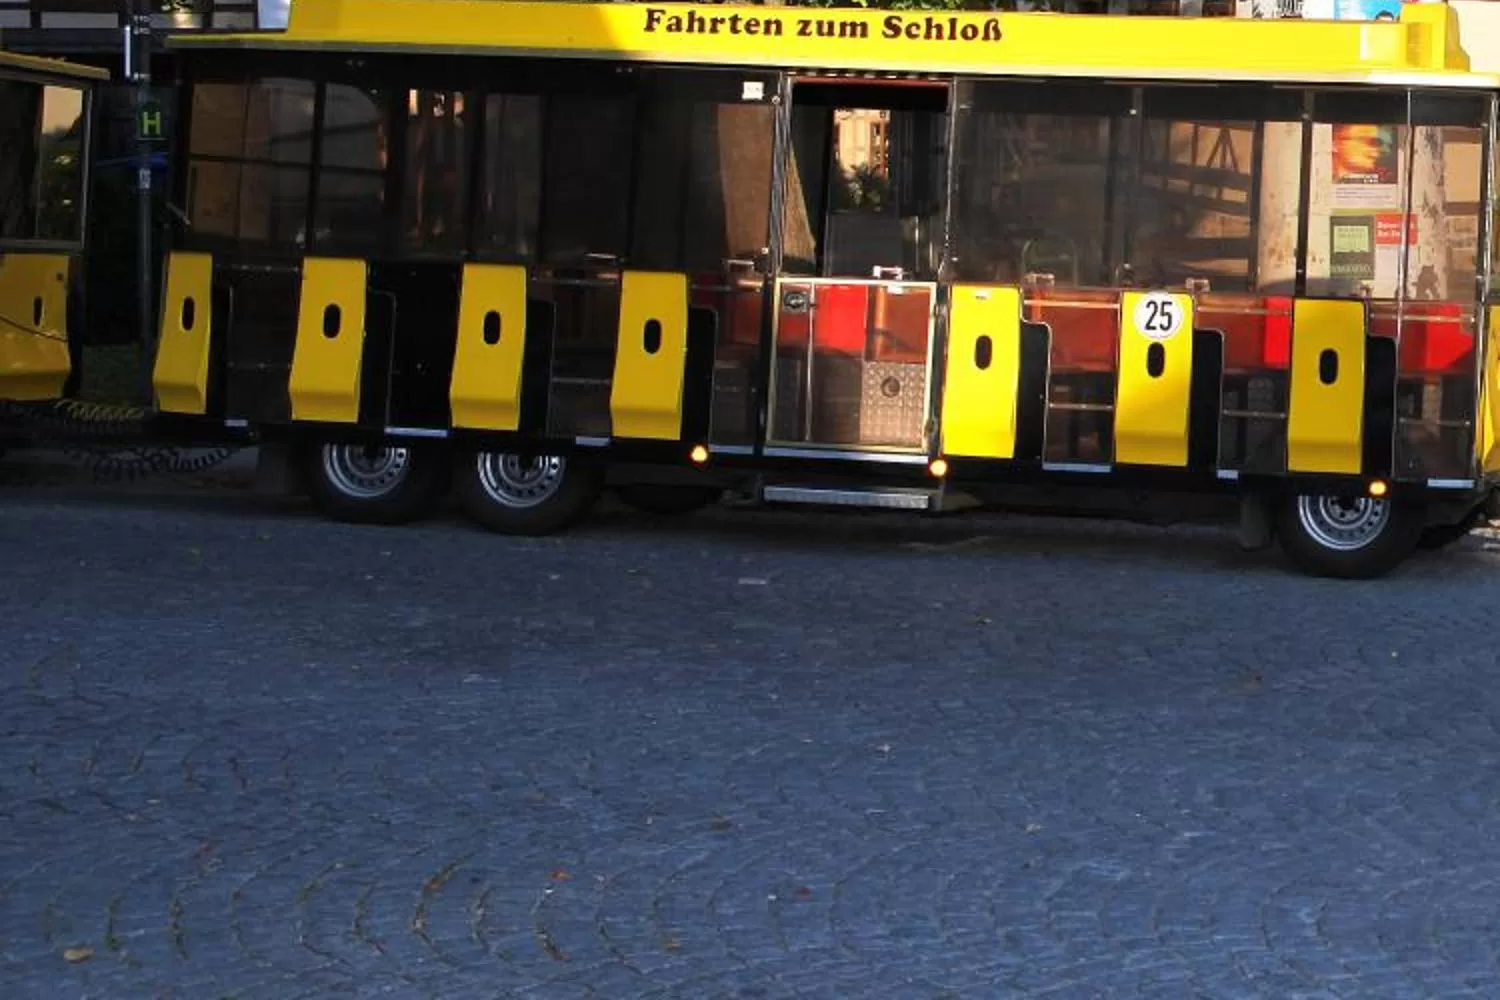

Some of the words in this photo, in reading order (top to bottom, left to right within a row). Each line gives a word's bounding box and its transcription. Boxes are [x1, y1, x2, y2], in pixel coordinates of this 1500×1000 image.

[644, 8, 783, 36] Fahrten
[799, 18, 869, 38] zum
[881, 15, 1002, 41] Schloß
[143, 111, 161, 135] H
[1145, 300, 1173, 331] 25
